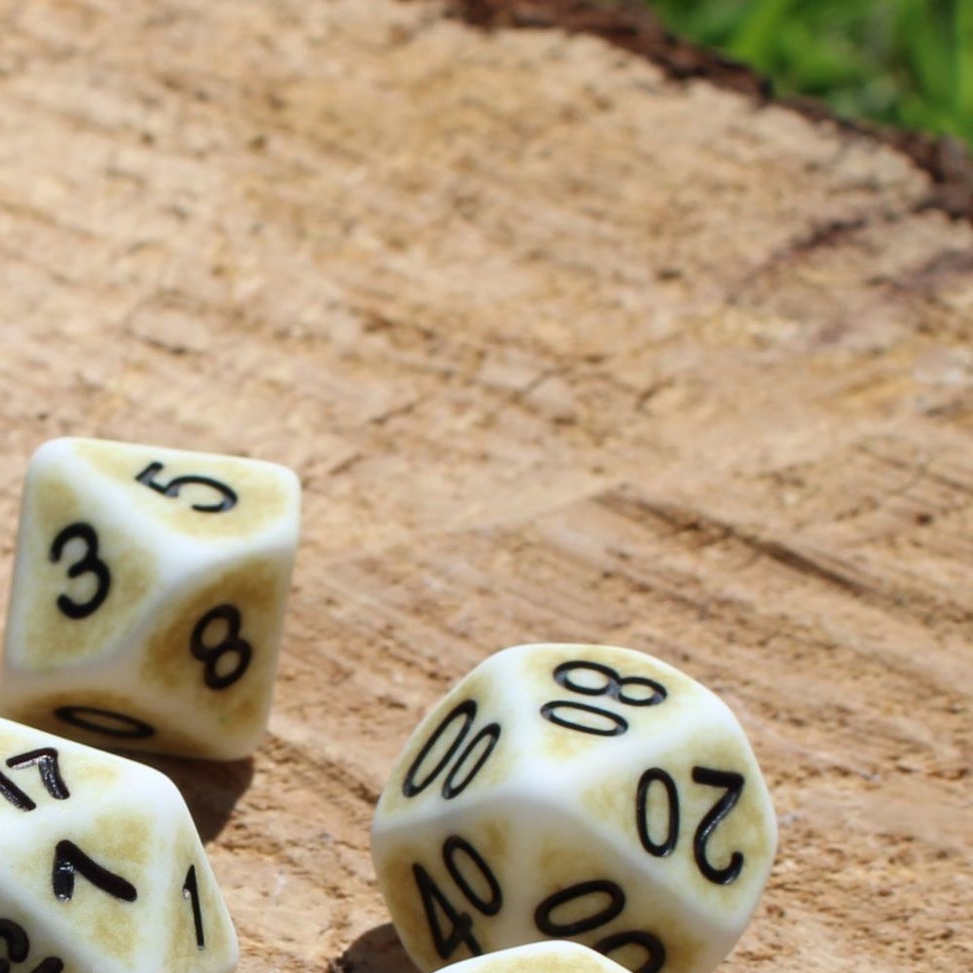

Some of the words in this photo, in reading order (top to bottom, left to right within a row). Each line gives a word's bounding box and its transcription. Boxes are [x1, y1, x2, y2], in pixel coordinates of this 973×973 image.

[135, 461, 237, 513] 5
[49, 522, 111, 620] 3
[189, 604, 251, 691] 8
[54, 706, 155, 739] 0
[540, 660, 668, 737] 80
[403, 700, 501, 800] 00
[636, 766, 745, 885] 20
[53, 840, 137, 903] 7
[183, 865, 204, 950] 1
[412, 836, 502, 960] 40
